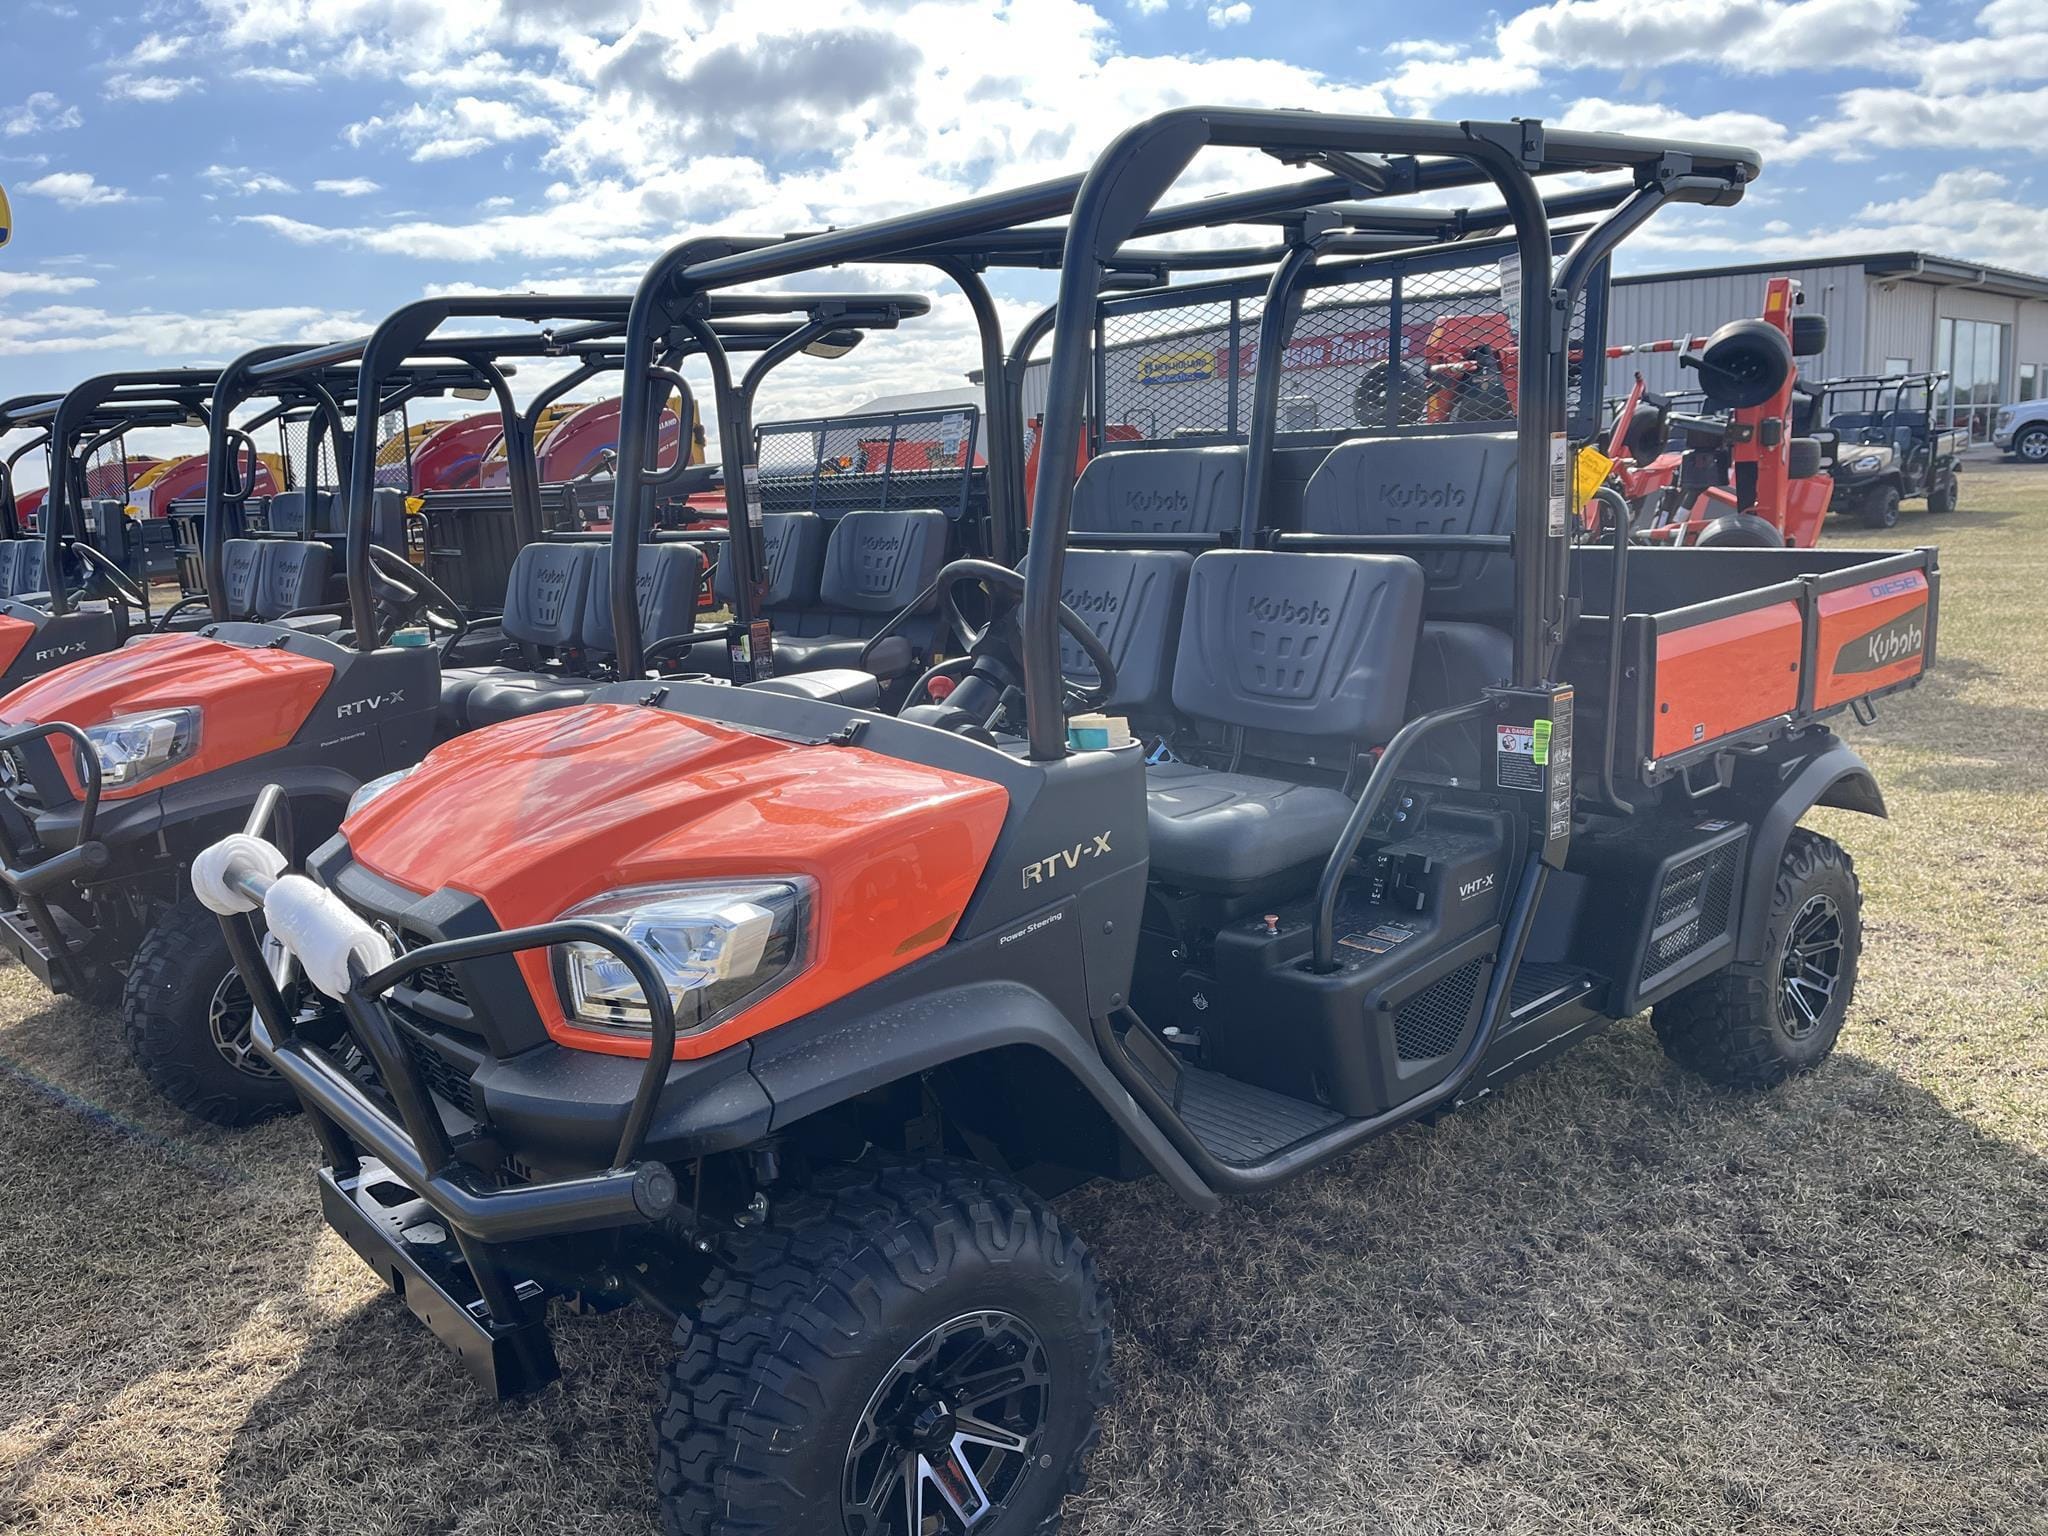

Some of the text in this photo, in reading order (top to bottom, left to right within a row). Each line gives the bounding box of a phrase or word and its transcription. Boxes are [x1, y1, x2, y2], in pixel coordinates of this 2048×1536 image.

[1126, 489, 1188, 511] Kubota
[1379, 482, 1466, 508] Kubota
[862, 536, 899, 550] Kubota
[1870, 576, 1920, 598] DIESEL
[1249, 596, 1331, 626] Kubota
[35, 640, 87, 661] RTV-X
[1868, 623, 1922, 663] Kubota
[336, 689, 405, 719] RTV-X
[1022, 830, 1112, 889] RTV-X
[1459, 873, 1494, 897] VHT-X
[999, 912, 1062, 945] Power Steering
